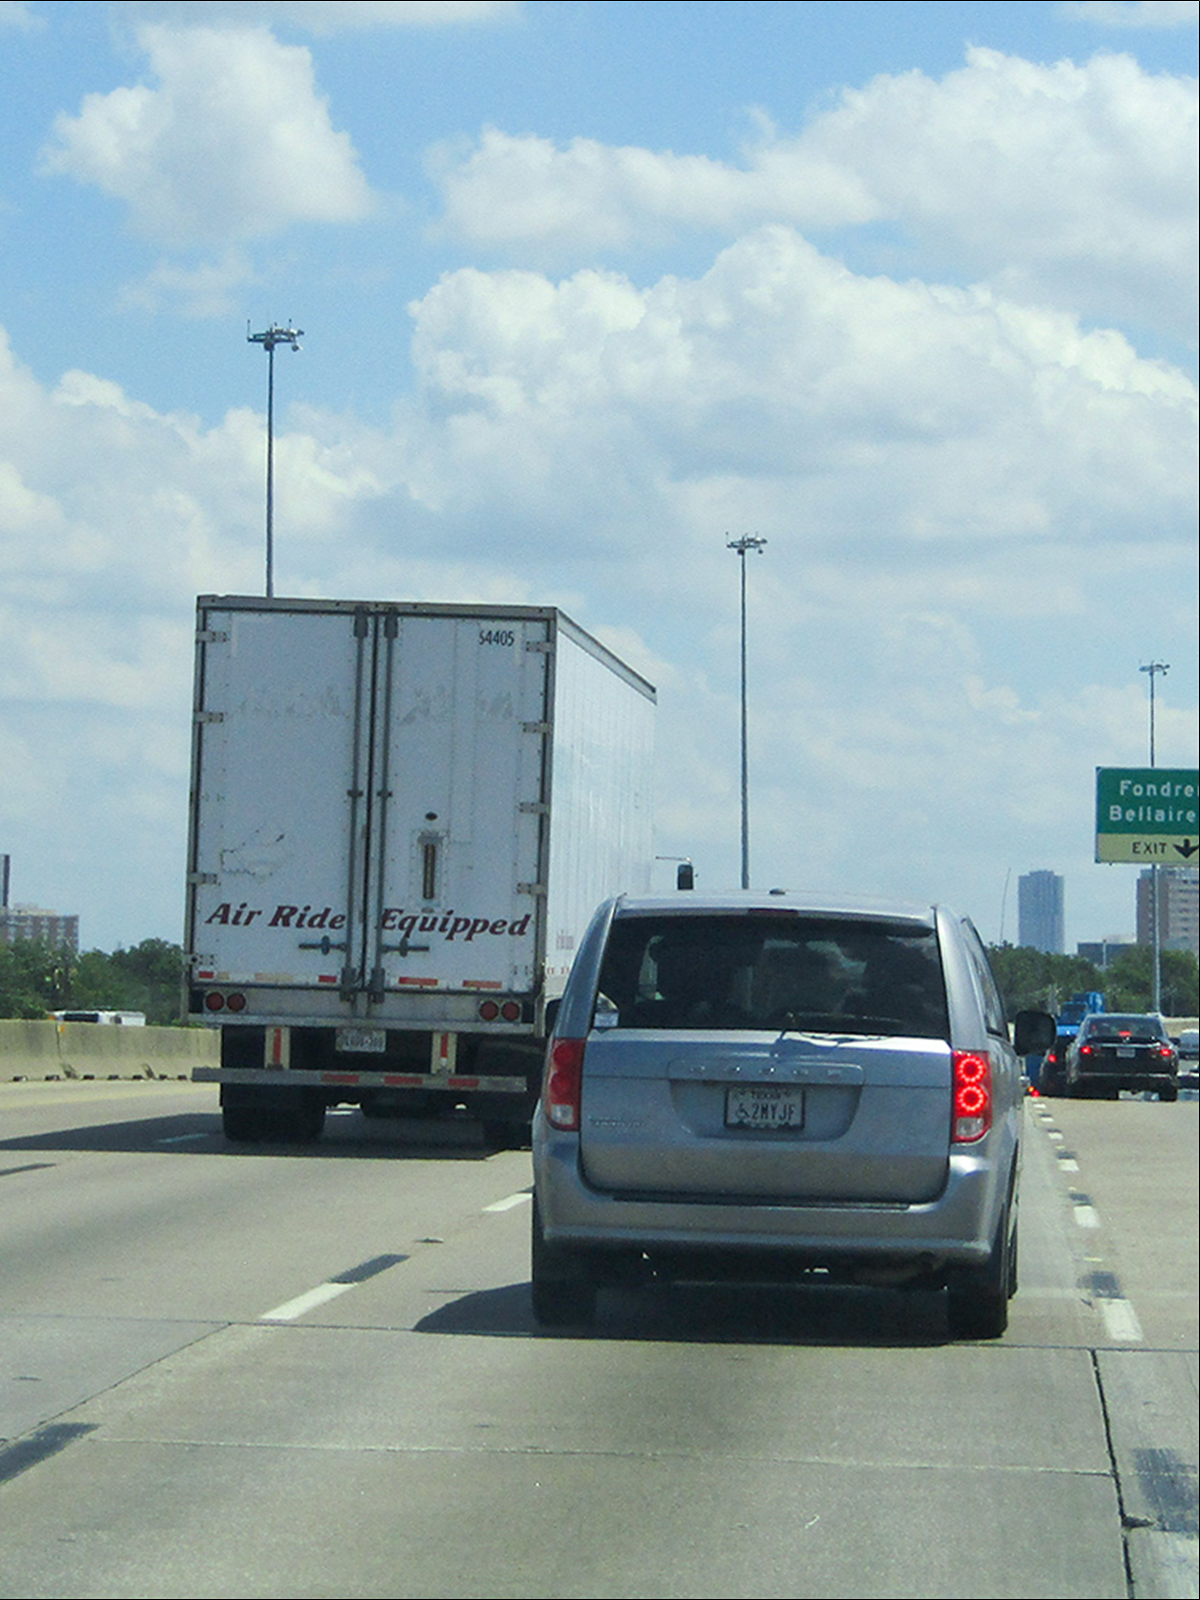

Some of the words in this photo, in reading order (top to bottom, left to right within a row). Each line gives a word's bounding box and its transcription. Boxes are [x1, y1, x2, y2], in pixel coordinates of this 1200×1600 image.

[1120, 780, 1199, 798] Fondre
[1109, 804, 1196, 823] Bellaire
[1132, 842, 1167, 855] EXIT
[205, 903, 261, 927] Air
[268, 905, 346, 930] Ride
[376, 907, 532, 942] Equipped
[751, 1103, 796, 1121] 2MYJF
